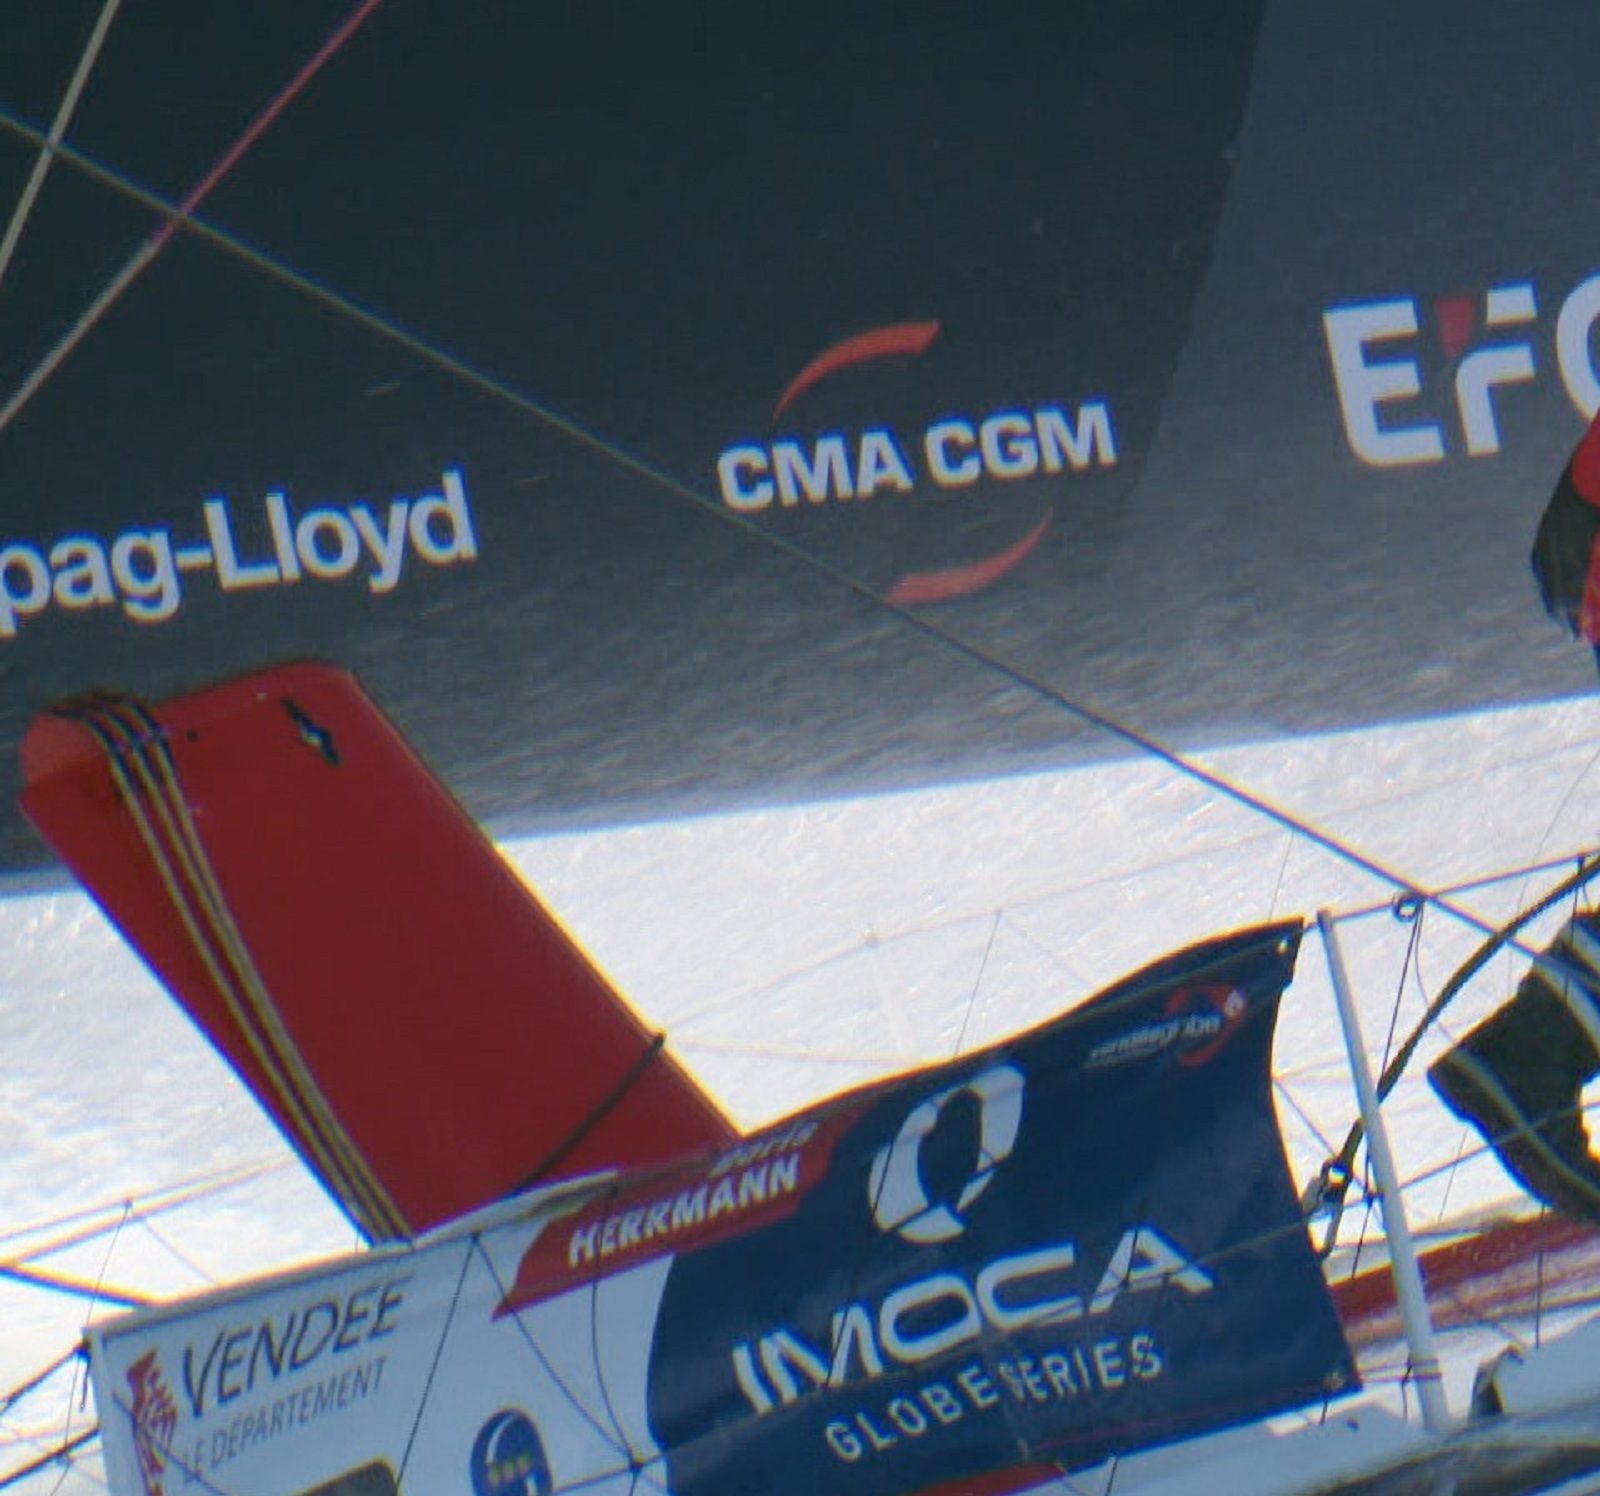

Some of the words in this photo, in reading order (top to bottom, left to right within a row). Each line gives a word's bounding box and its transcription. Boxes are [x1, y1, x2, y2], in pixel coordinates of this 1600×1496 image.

[717, 430, 911, 512] CMA
[924, 399, 1118, 487] CGM
[567, 1152, 800, 1269] HERRMANN
[732, 1227, 1212, 1416] IMOCA
[825, 1363, 999, 1463] GLOBE
[998, 1333, 1164, 1402] SERIES
